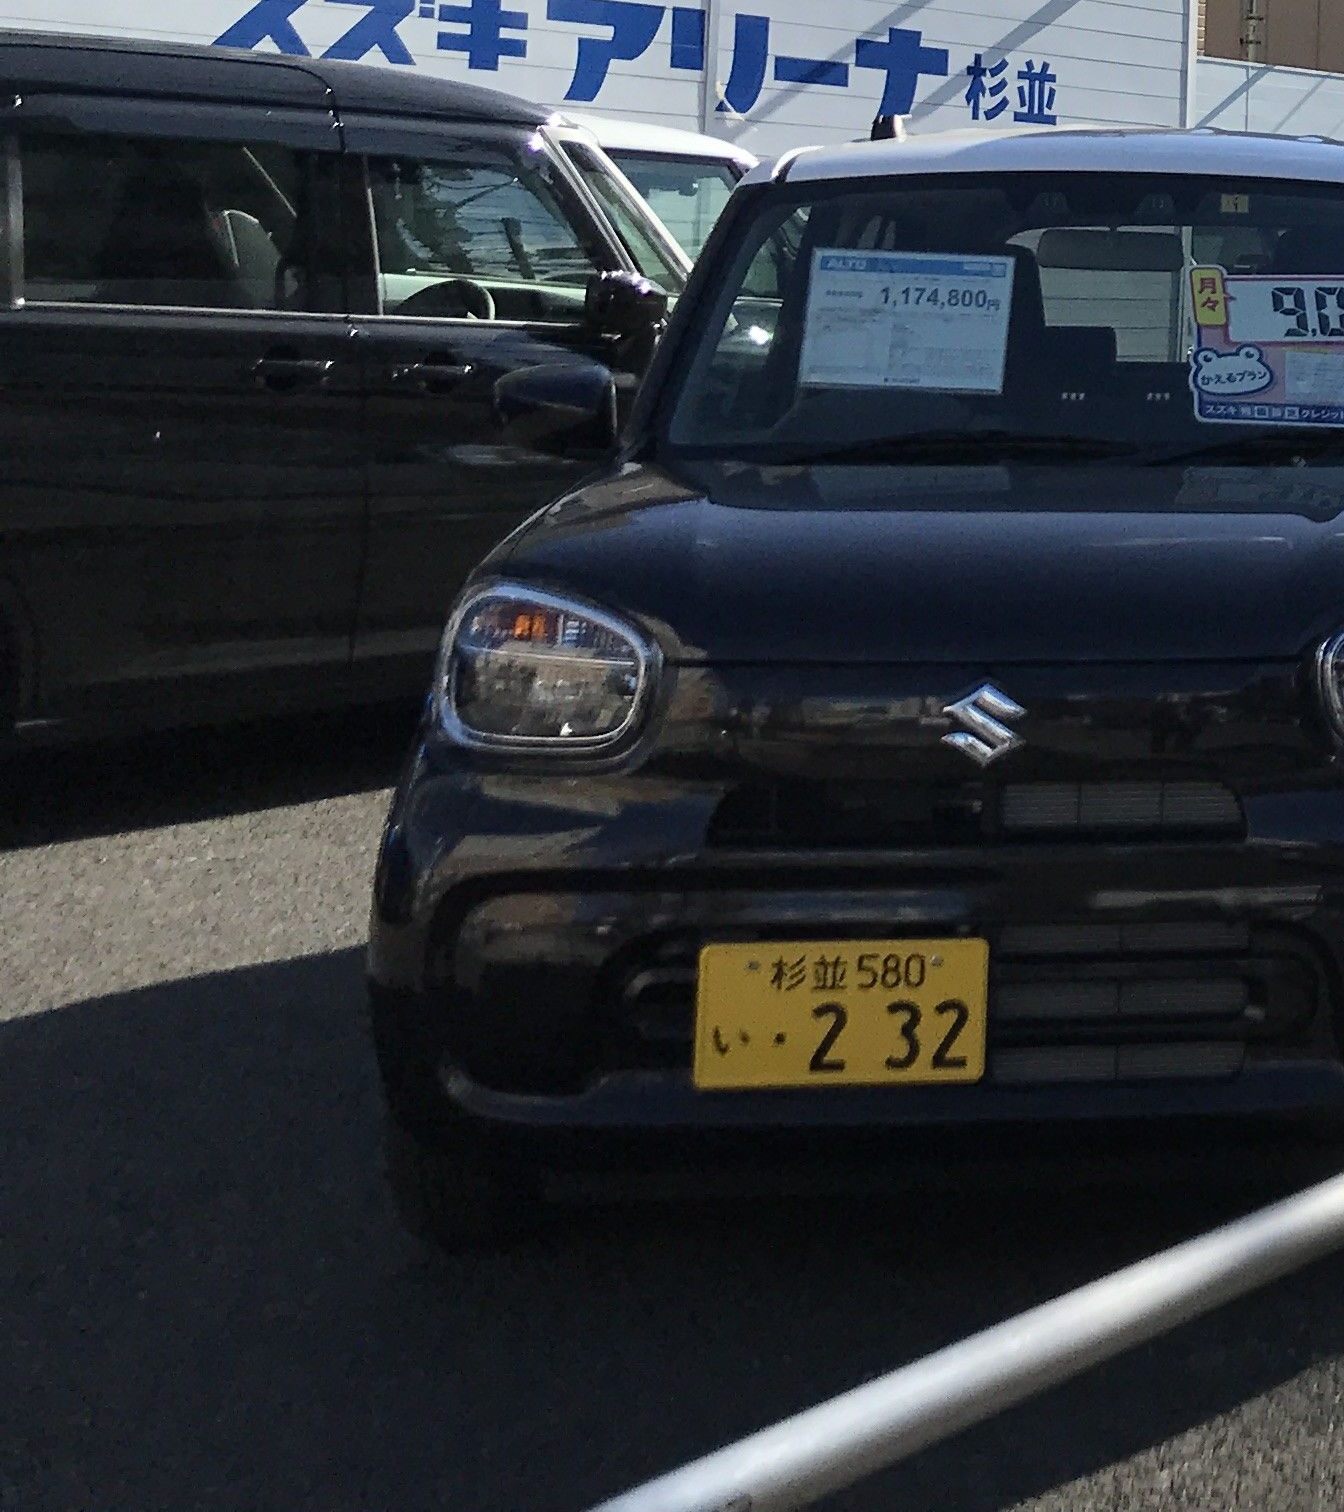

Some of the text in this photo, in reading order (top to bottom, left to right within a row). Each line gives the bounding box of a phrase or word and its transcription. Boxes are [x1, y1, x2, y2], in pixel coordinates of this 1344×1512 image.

[1199, 277, 1220, 312] 月々
[770, 952, 927, 992] 杉並 580
